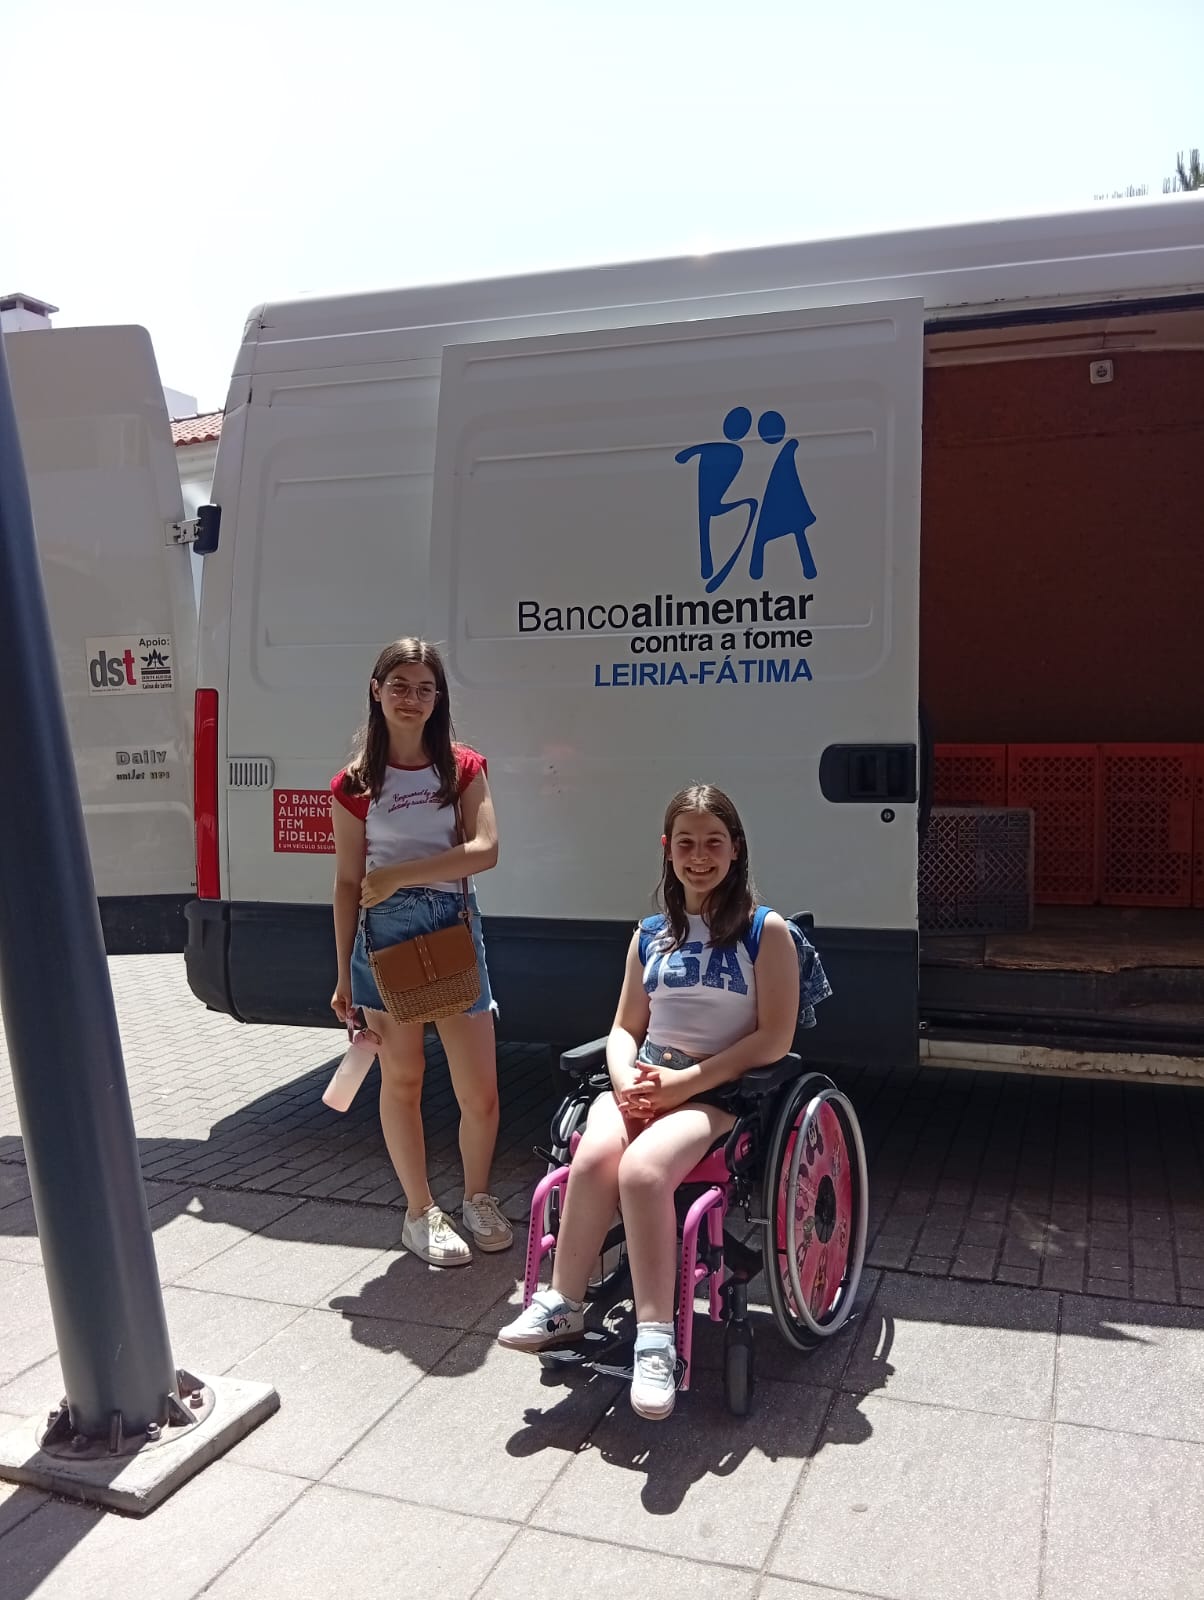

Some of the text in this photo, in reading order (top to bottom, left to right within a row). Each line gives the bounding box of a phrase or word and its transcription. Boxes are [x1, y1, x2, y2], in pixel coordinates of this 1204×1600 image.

[518, 590, 813, 632] Bancoalimentar
[139, 637, 170, 648] Apoio:
[631, 627, 813, 653] contra a fome
[90, 649, 137, 688] dst
[594, 655, 813, 686] LEIRIA-FÁTIMA
[116, 750, 167, 766] Daily
[278, 794, 288, 804] O
[278, 806, 332, 817] ALIMENT
[278, 818, 304, 829] TEM
[278, 830, 336, 842] FIDELIDA
